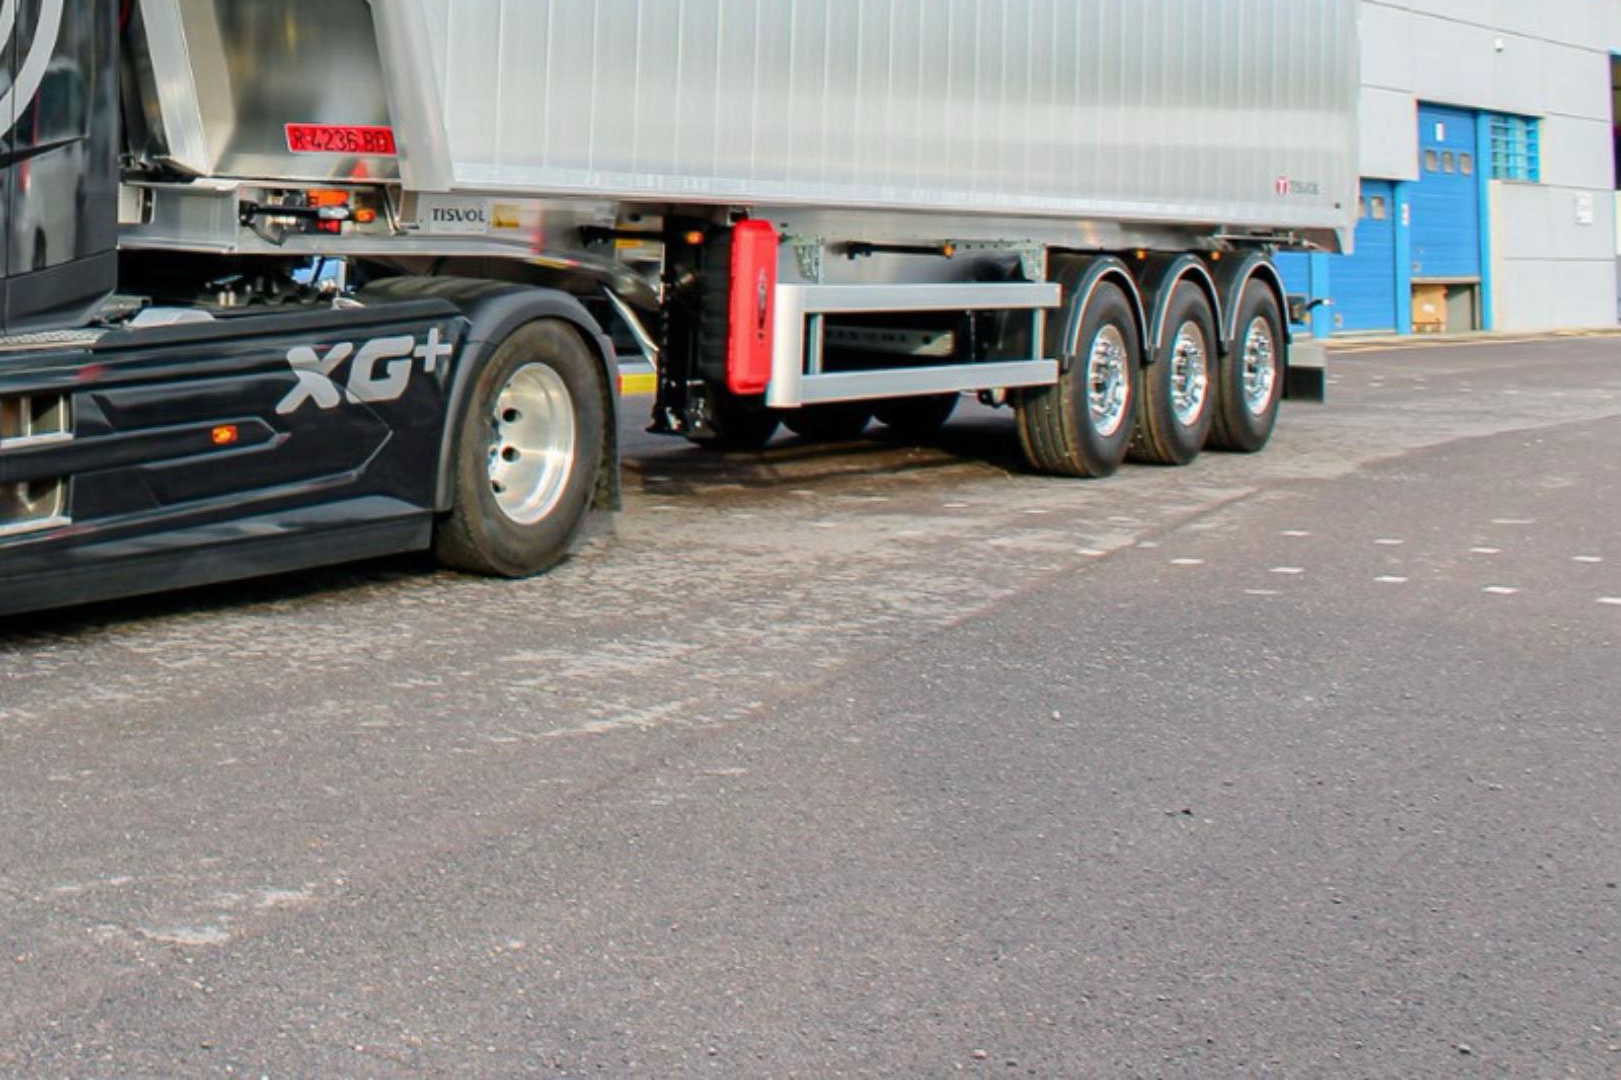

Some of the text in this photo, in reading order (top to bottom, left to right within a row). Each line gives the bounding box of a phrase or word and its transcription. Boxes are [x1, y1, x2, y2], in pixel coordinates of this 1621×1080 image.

[310, 127, 360, 153] 4236
[432, 208, 485, 223] TISVOL
[275, 328, 453, 414] XG+
